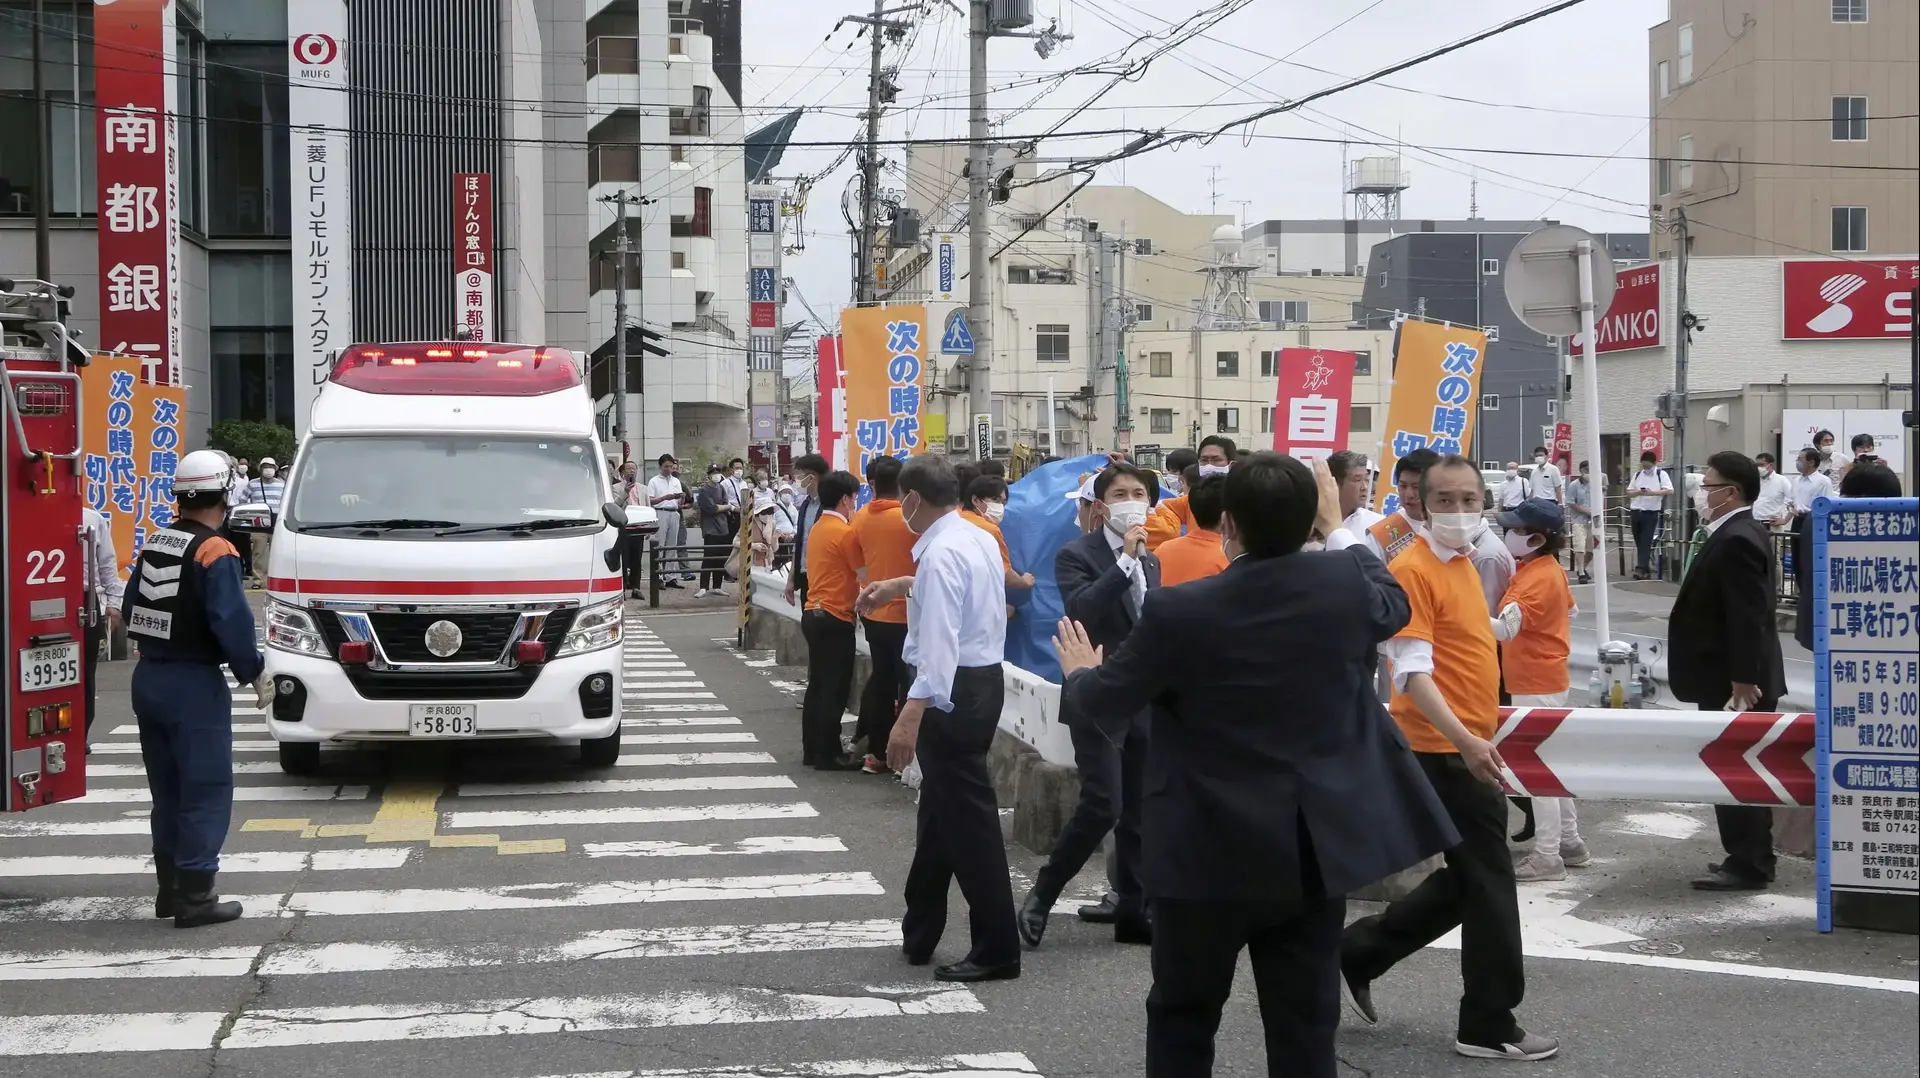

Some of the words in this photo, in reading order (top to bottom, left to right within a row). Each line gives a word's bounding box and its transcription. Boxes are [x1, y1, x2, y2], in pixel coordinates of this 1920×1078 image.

[301, 70, 330, 78] MUFG
[760, 269, 771, 300] AGA
[1593, 309, 1657, 344] ANKO
[107, 370, 137, 513] 次の時代を
[149, 398, 179, 529] 次の時代を
[1829, 512, 1916, 536] ご迷惑をおか
[26, 549, 66, 585] 22
[1830, 557, 1919, 593] 駅前広場を大
[132, 613, 169, 632] 西大寺分署
[33, 660, 77, 686] 99-95
[1858, 691, 1874, 714] 昼間
[424, 717, 472, 733] 58-03
[1858, 724, 1874, 746] 夜間
[1876, 723, 1917, 748] 22:00
[1832, 795, 1853, 805] 発注者
[1862, 796, 1892, 807] 奈良市
[1862, 821, 1880, 832] 電話
[1832, 841, 1854, 851] 施工者
[1863, 868, 1880, 879] 電話
